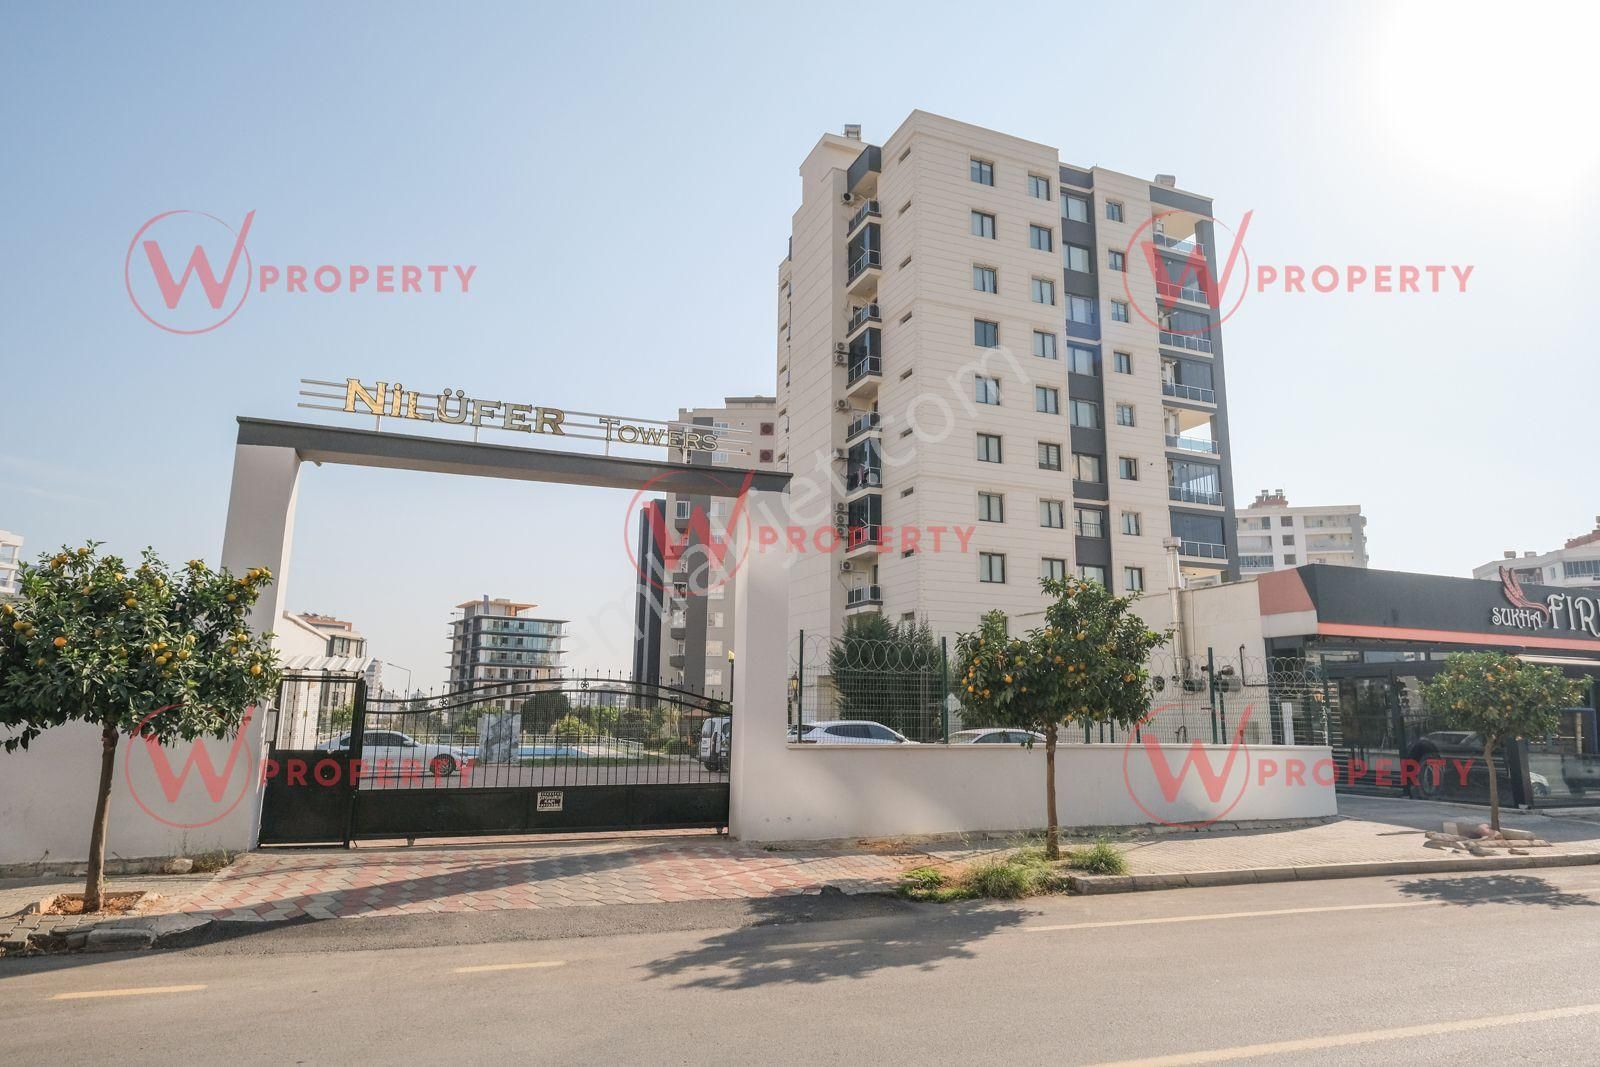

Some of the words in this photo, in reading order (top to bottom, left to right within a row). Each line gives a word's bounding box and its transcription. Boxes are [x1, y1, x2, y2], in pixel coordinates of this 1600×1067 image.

[599, 417, 718, 452] TOWERS
[1492, 607, 1543, 631] SUKHA
[1546, 592, 1600, 638] FIR
